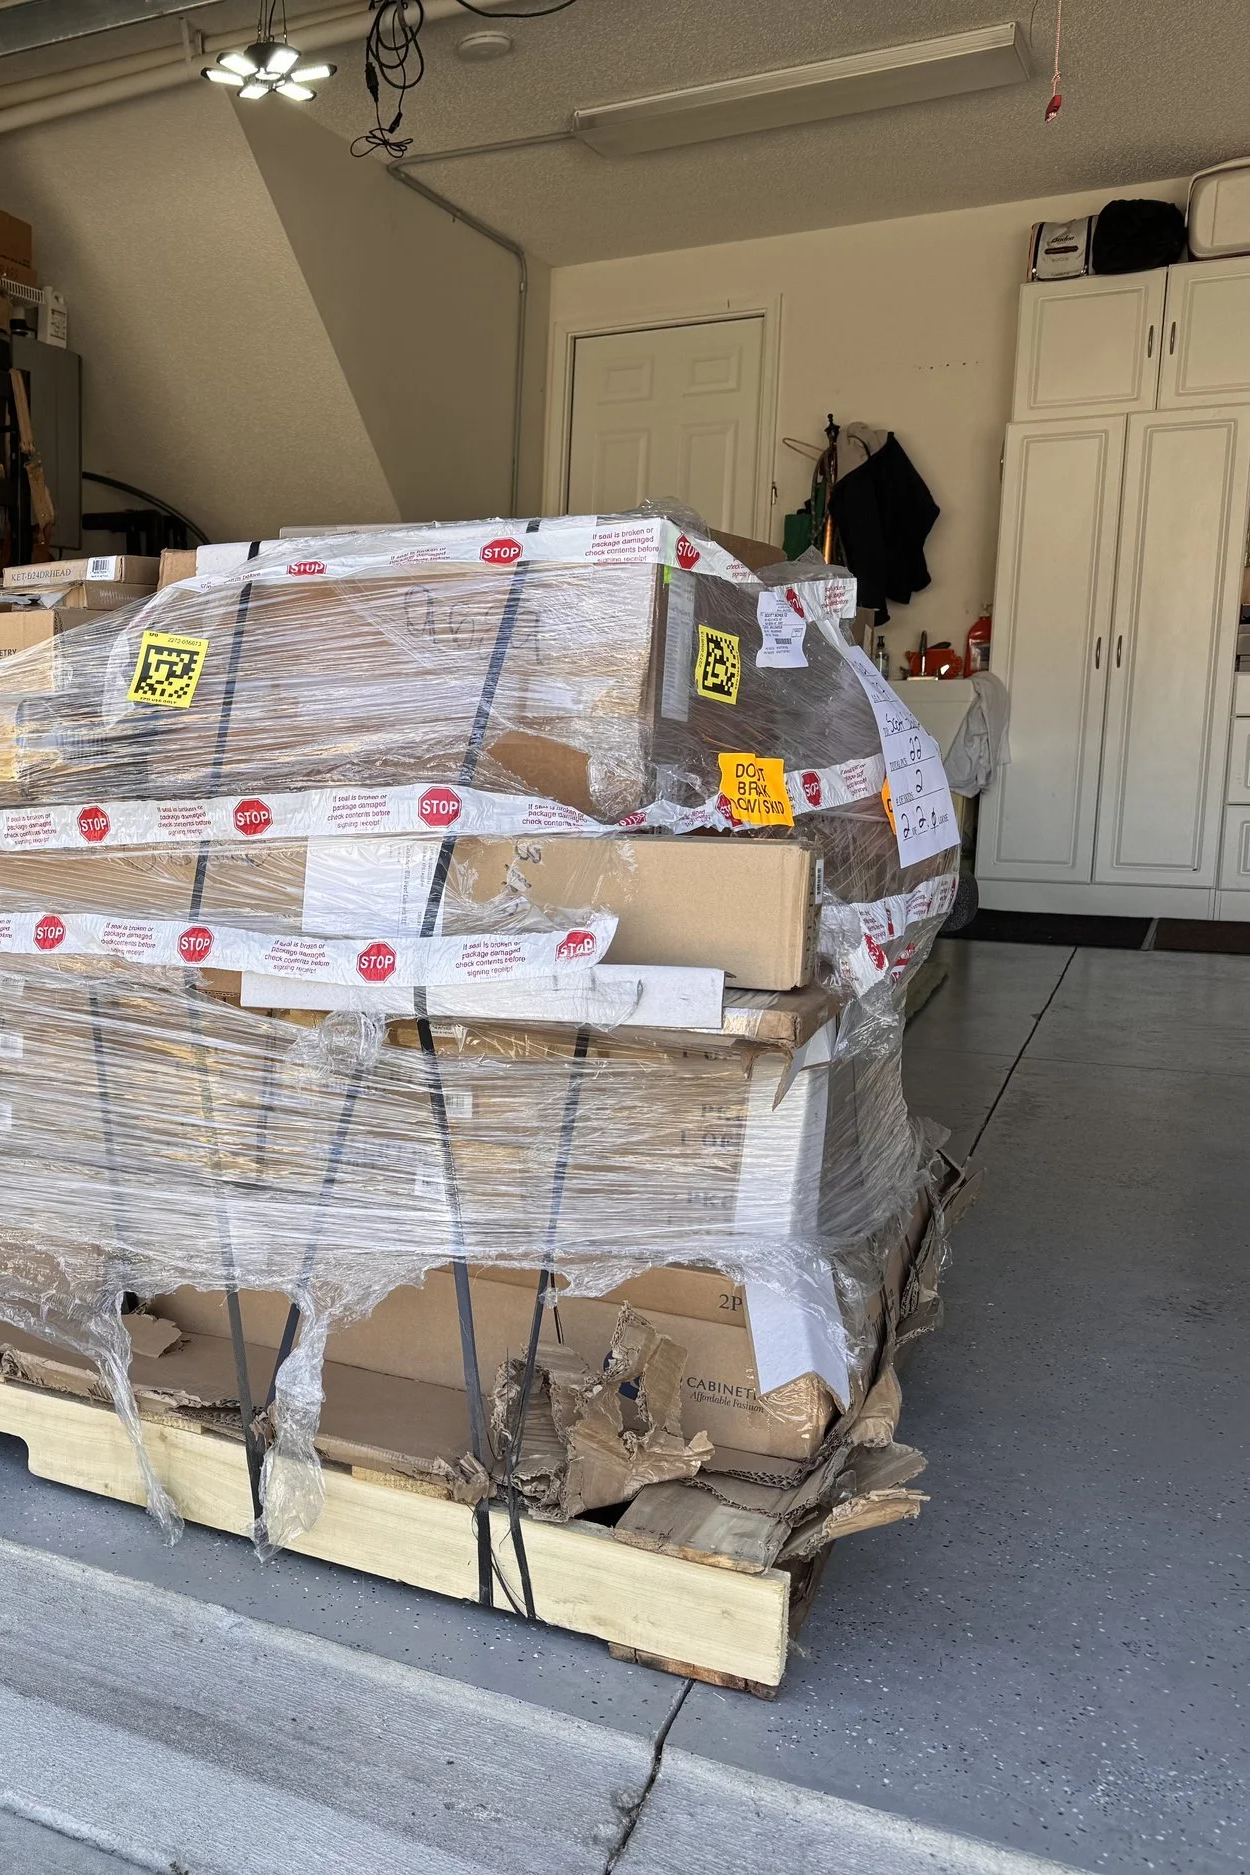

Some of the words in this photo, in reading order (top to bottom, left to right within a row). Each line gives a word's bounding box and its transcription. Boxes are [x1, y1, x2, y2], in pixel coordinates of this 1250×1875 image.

[622, 529, 645, 538] broken
[592, 539, 620, 549] package
[622, 536, 654, 546] damaged
[483, 548, 520, 559] STOP
[584, 549, 604, 557] check
[605, 547, 636, 556] contents
[638, 545, 659, 553] before
[290, 562, 324, 573] STOP
[915, 769, 923, 793] 2
[333, 804, 357, 813] package
[358, 800, 386, 809] damaged
[422, 799, 458, 815] STOP
[763, 799, 784, 815] SKID
[237, 811, 269, 827] STOP
[528, 810, 556, 818] package
[81, 817, 108, 832] STOP
[522, 818, 542, 826] check
[901, 813, 910, 839] 2
[37, 927, 62, 940] STOP
[180, 937, 210, 951] STOP
[300, 942, 317, 950] broken
[469, 942, 482, 950] seal
[490, 941, 512, 949] broken
[265, 954, 282, 962] check
[283, 957, 310, 965] contents
[271, 946, 298, 956] package
[299, 950, 326, 960] damaged
[462, 951, 489, 960] package
[490, 947, 521, 957] damaged
[361, 956, 394, 969] STOP
[455, 960, 474, 968] check
[475, 958, 504, 966] contents
[467, 970, 490, 978] signing
[491, 966, 513, 974] receipt
[690, 1391, 731, 1408] Affordable
